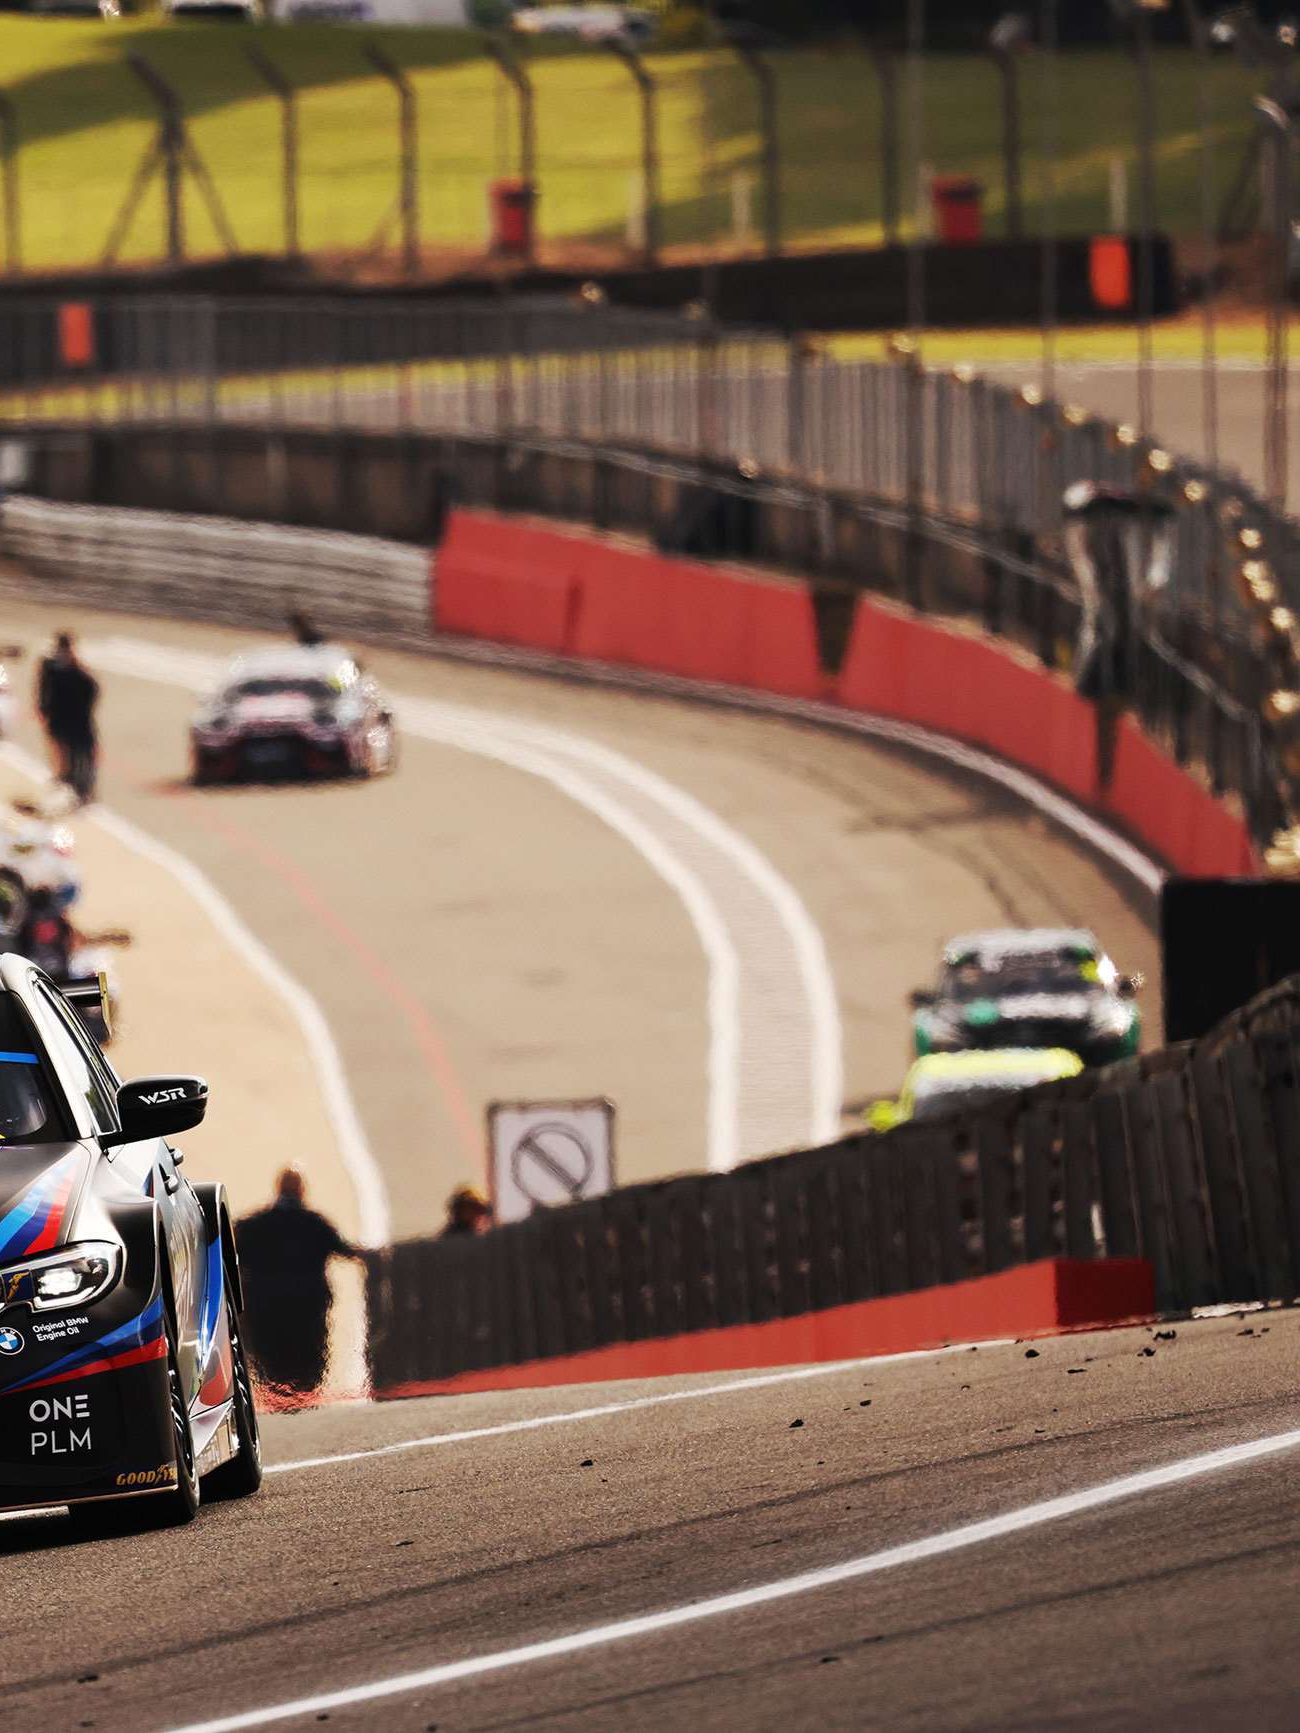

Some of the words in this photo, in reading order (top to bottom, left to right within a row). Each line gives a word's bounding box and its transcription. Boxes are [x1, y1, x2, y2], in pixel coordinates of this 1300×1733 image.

[138, 1087, 187, 1105] WSR
[32, 1321, 66, 1333] Original
[66, 1316, 90, 1327] BMW
[36, 1330, 67, 1342] Engine
[67, 1326, 80, 1335] Oil
[29, 1394, 91, 1422] ONE
[30, 1427, 92, 1456] PLM
